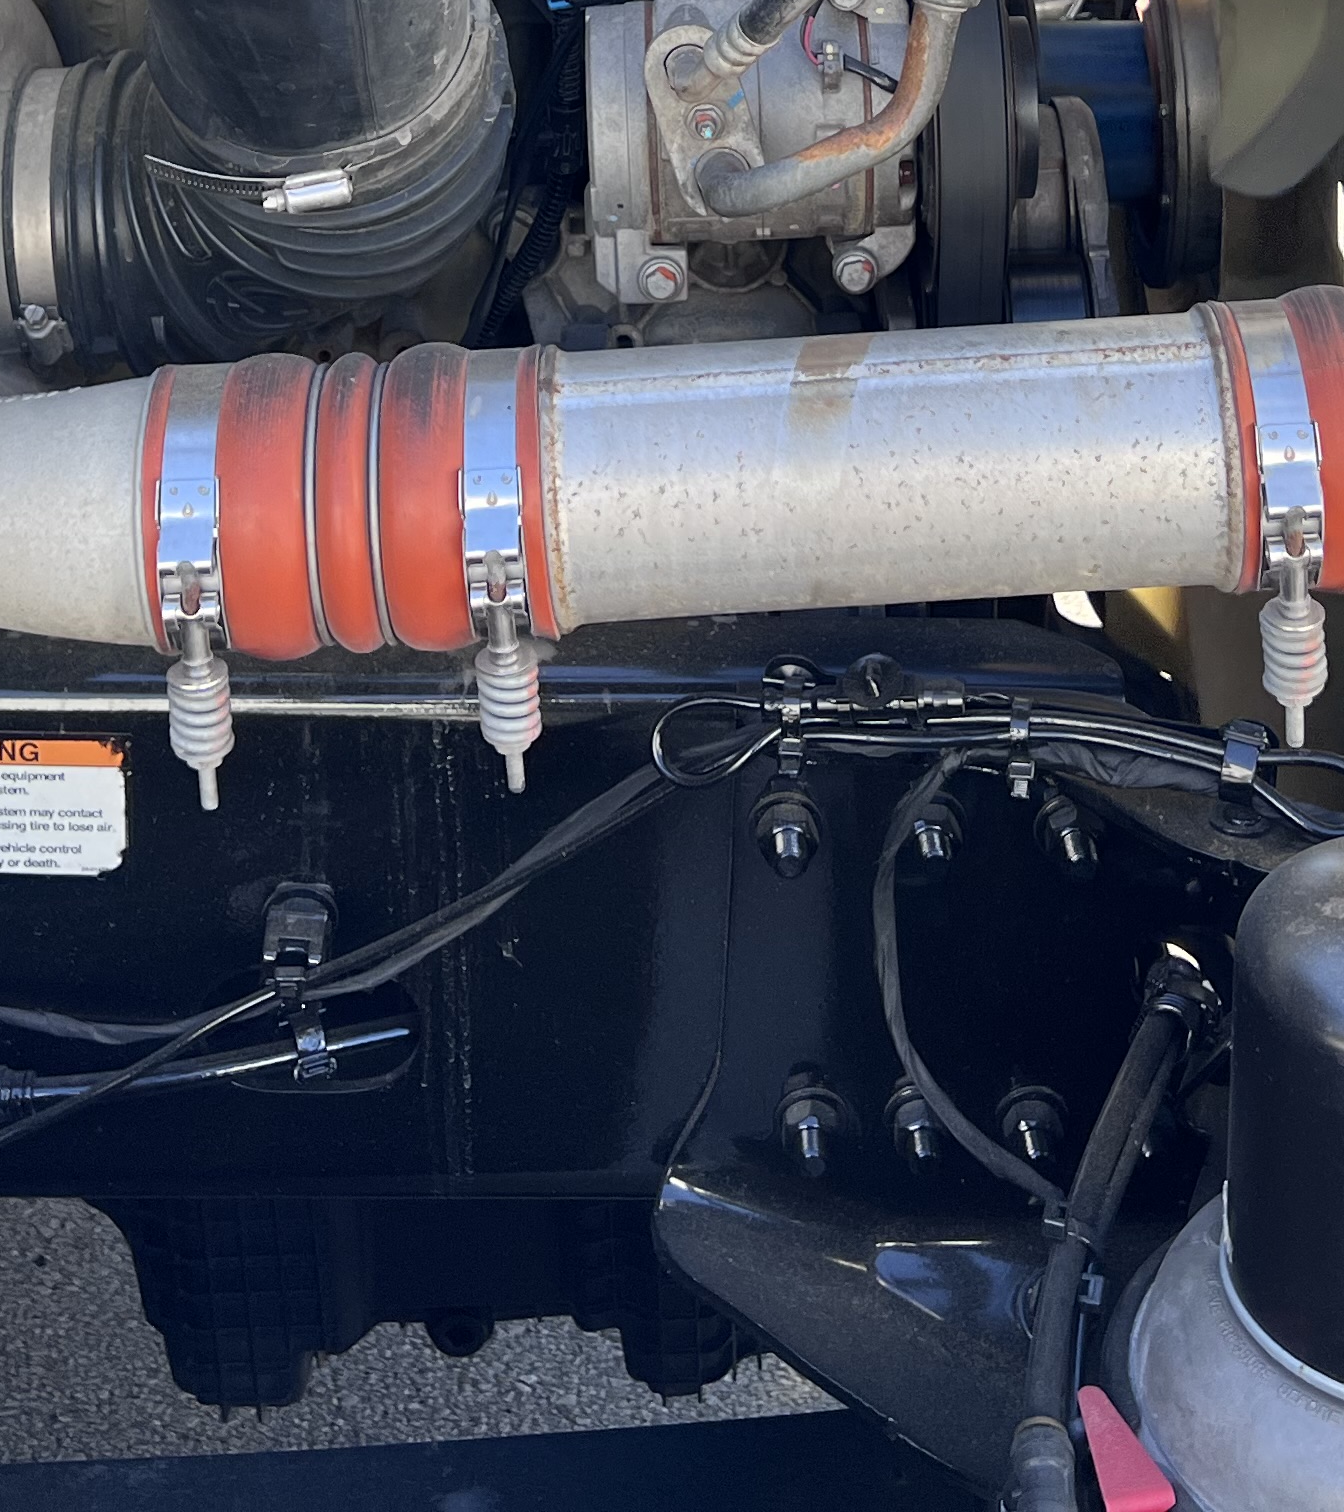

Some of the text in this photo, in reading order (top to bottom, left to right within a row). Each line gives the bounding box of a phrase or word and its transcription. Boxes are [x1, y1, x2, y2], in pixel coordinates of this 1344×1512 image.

[0, 771, 65, 783] equipment
[29, 808, 54, 819] may
[58, 808, 103, 818] contact
[29, 821, 50, 831] tire
[53, 821, 65, 832] to
[68, 822, 94, 832] lose
[96, 822, 117, 833] air.
[39, 843, 82, 854] control
[8, 858, 21, 868] or
[23, 858, 61, 868] death.
